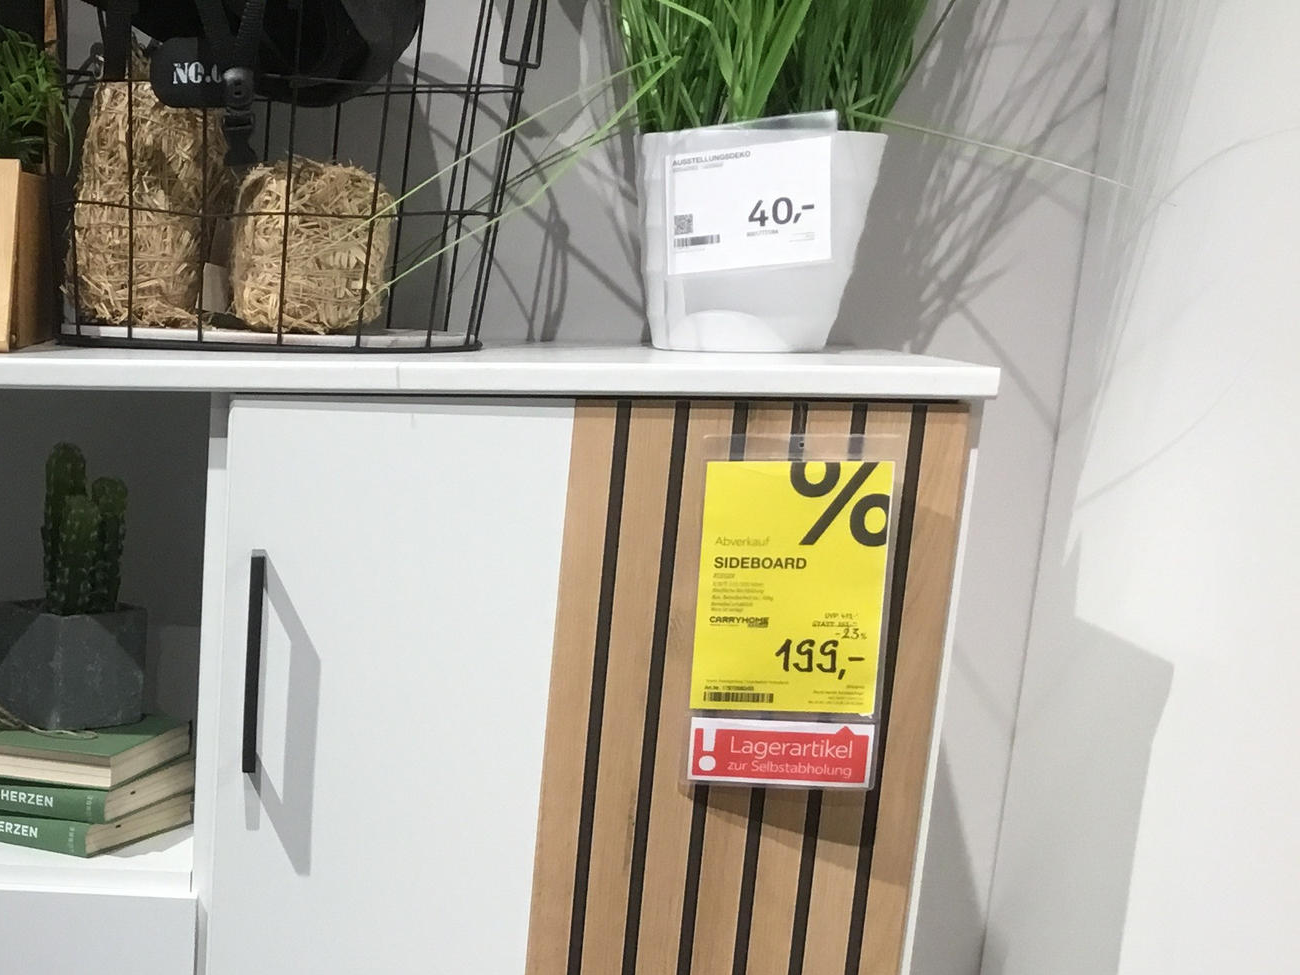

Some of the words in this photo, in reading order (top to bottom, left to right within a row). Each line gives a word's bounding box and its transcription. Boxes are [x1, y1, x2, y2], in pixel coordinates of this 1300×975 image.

[748, 197, 815, 227] 40,-
[715, 536, 770, 547] Abverkauf
[713, 556, 807, 570] SIDEBOARD
[709, 616, 769, 625] CARRYHOME
[775, 638, 865, 680] 199,-
[730, 736, 853, 759] Lagerartikel
[727, 762, 748, 771] zur
[751, 760, 852, 778] Selbstabholung
[1, 789, 54, 807] HERZEN
